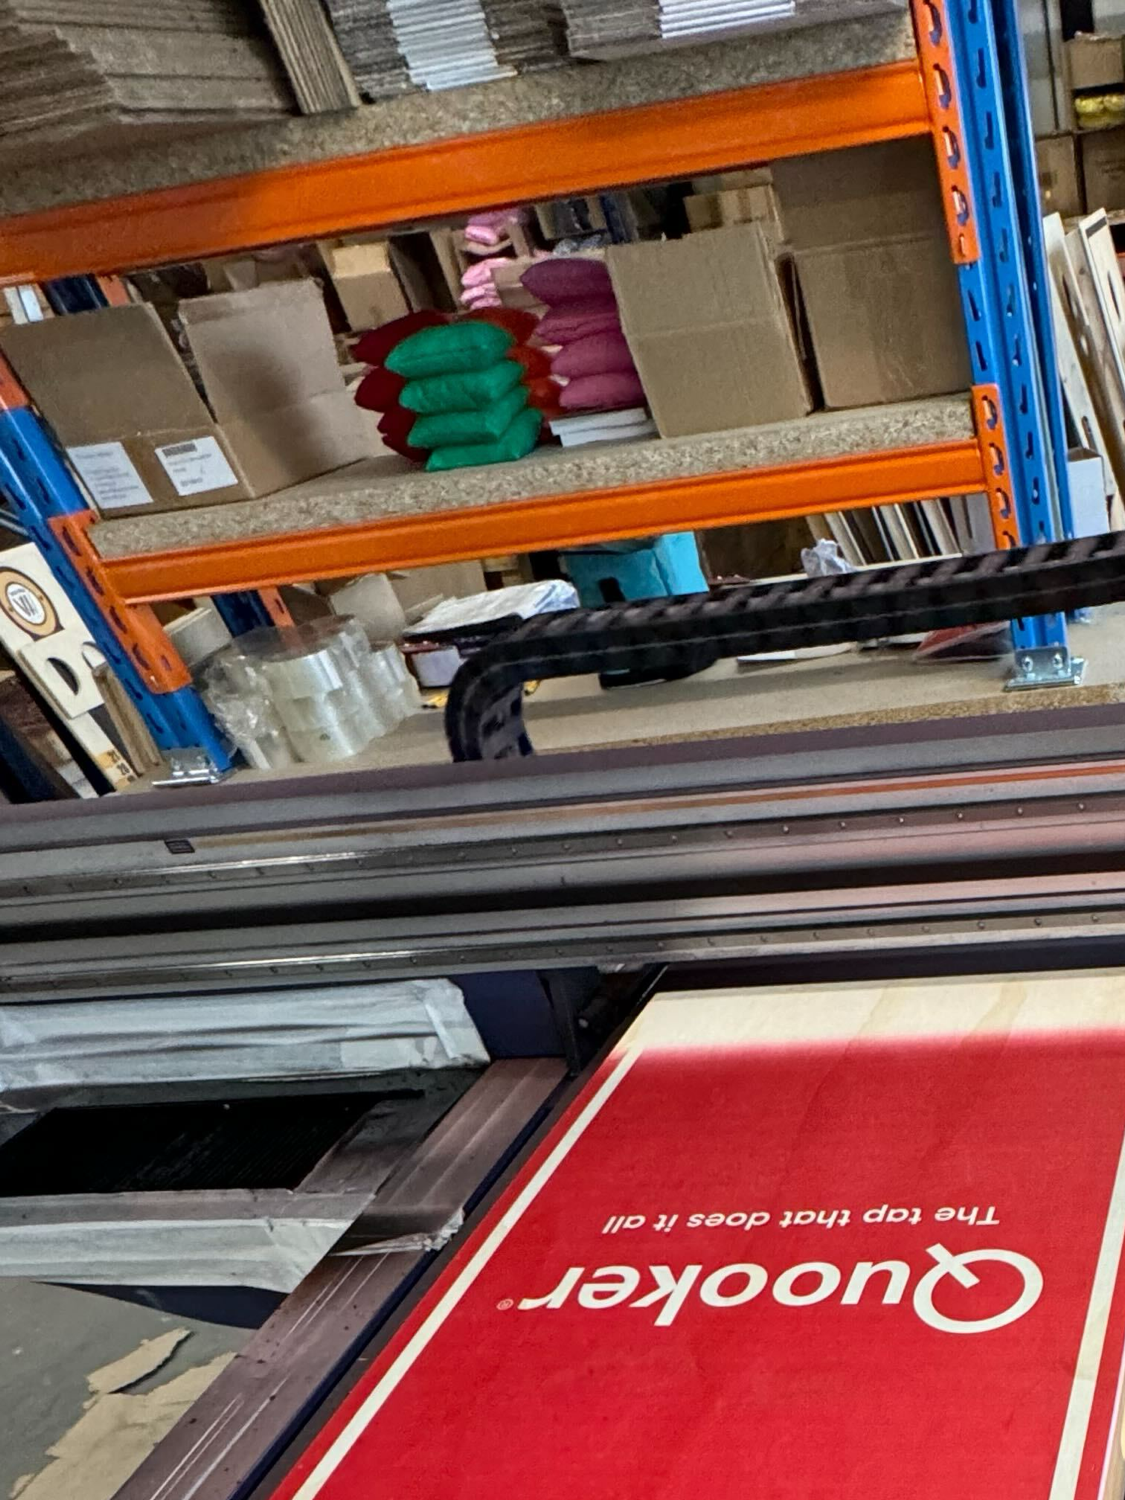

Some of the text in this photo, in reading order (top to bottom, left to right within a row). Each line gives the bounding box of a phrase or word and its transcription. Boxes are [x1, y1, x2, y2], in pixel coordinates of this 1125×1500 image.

[602, 1204, 1000, 1234] The tap that does it all
[517, 1242, 1044, 1334] Quooker
